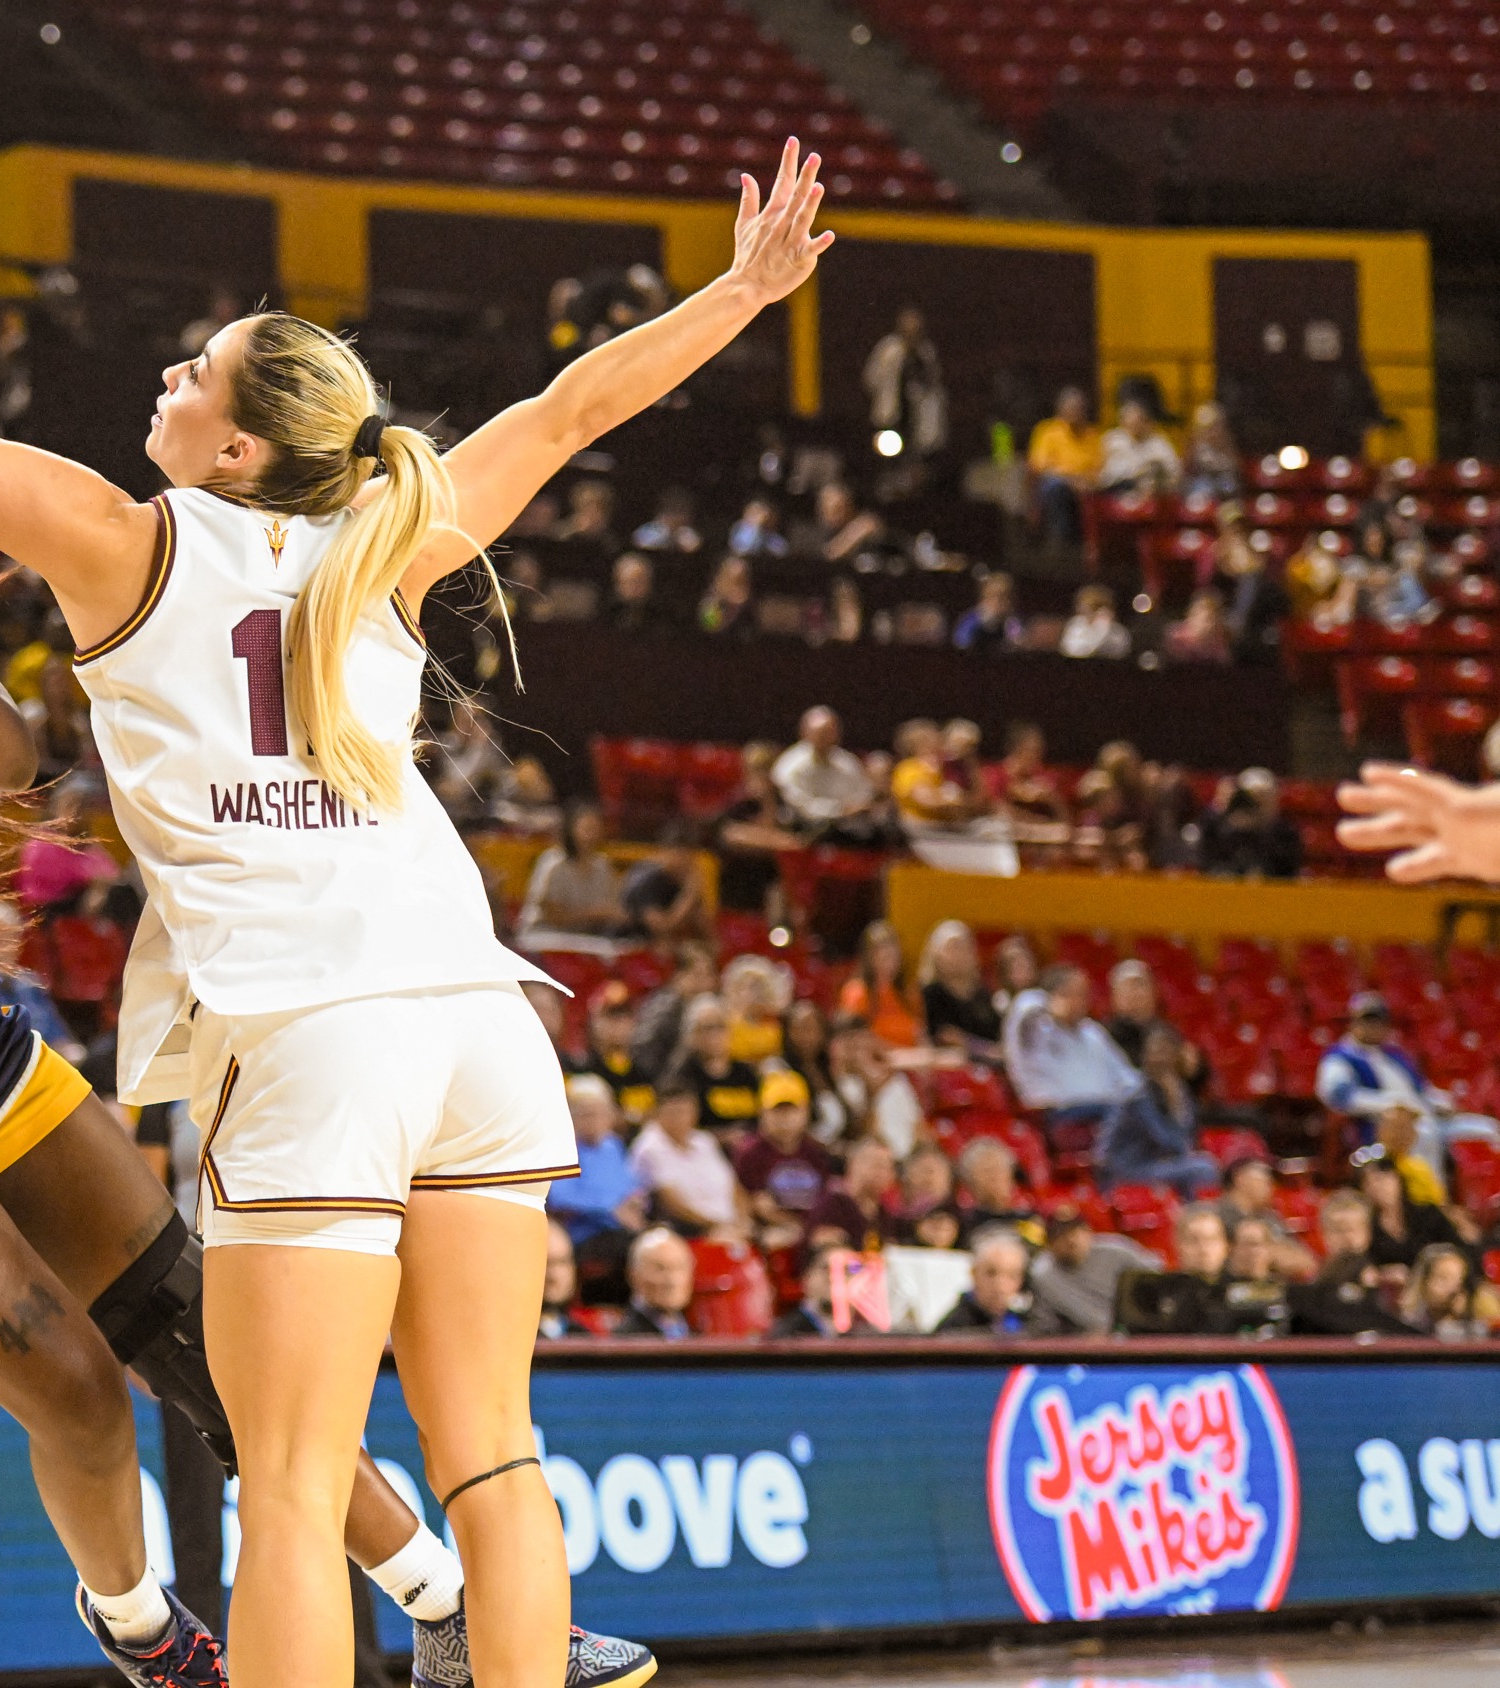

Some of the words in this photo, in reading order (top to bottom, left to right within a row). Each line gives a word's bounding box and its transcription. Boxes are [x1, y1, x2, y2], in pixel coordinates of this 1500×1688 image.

[231, 609, 316, 757] 1
[210, 779, 379, 830] WASHENI
[442, 1424, 809, 1576] bove
[1039, 1388, 1237, 1500] Jersey
[1355, 1437, 1419, 1544] a
[1068, 1474, 1254, 1610] Mike's
